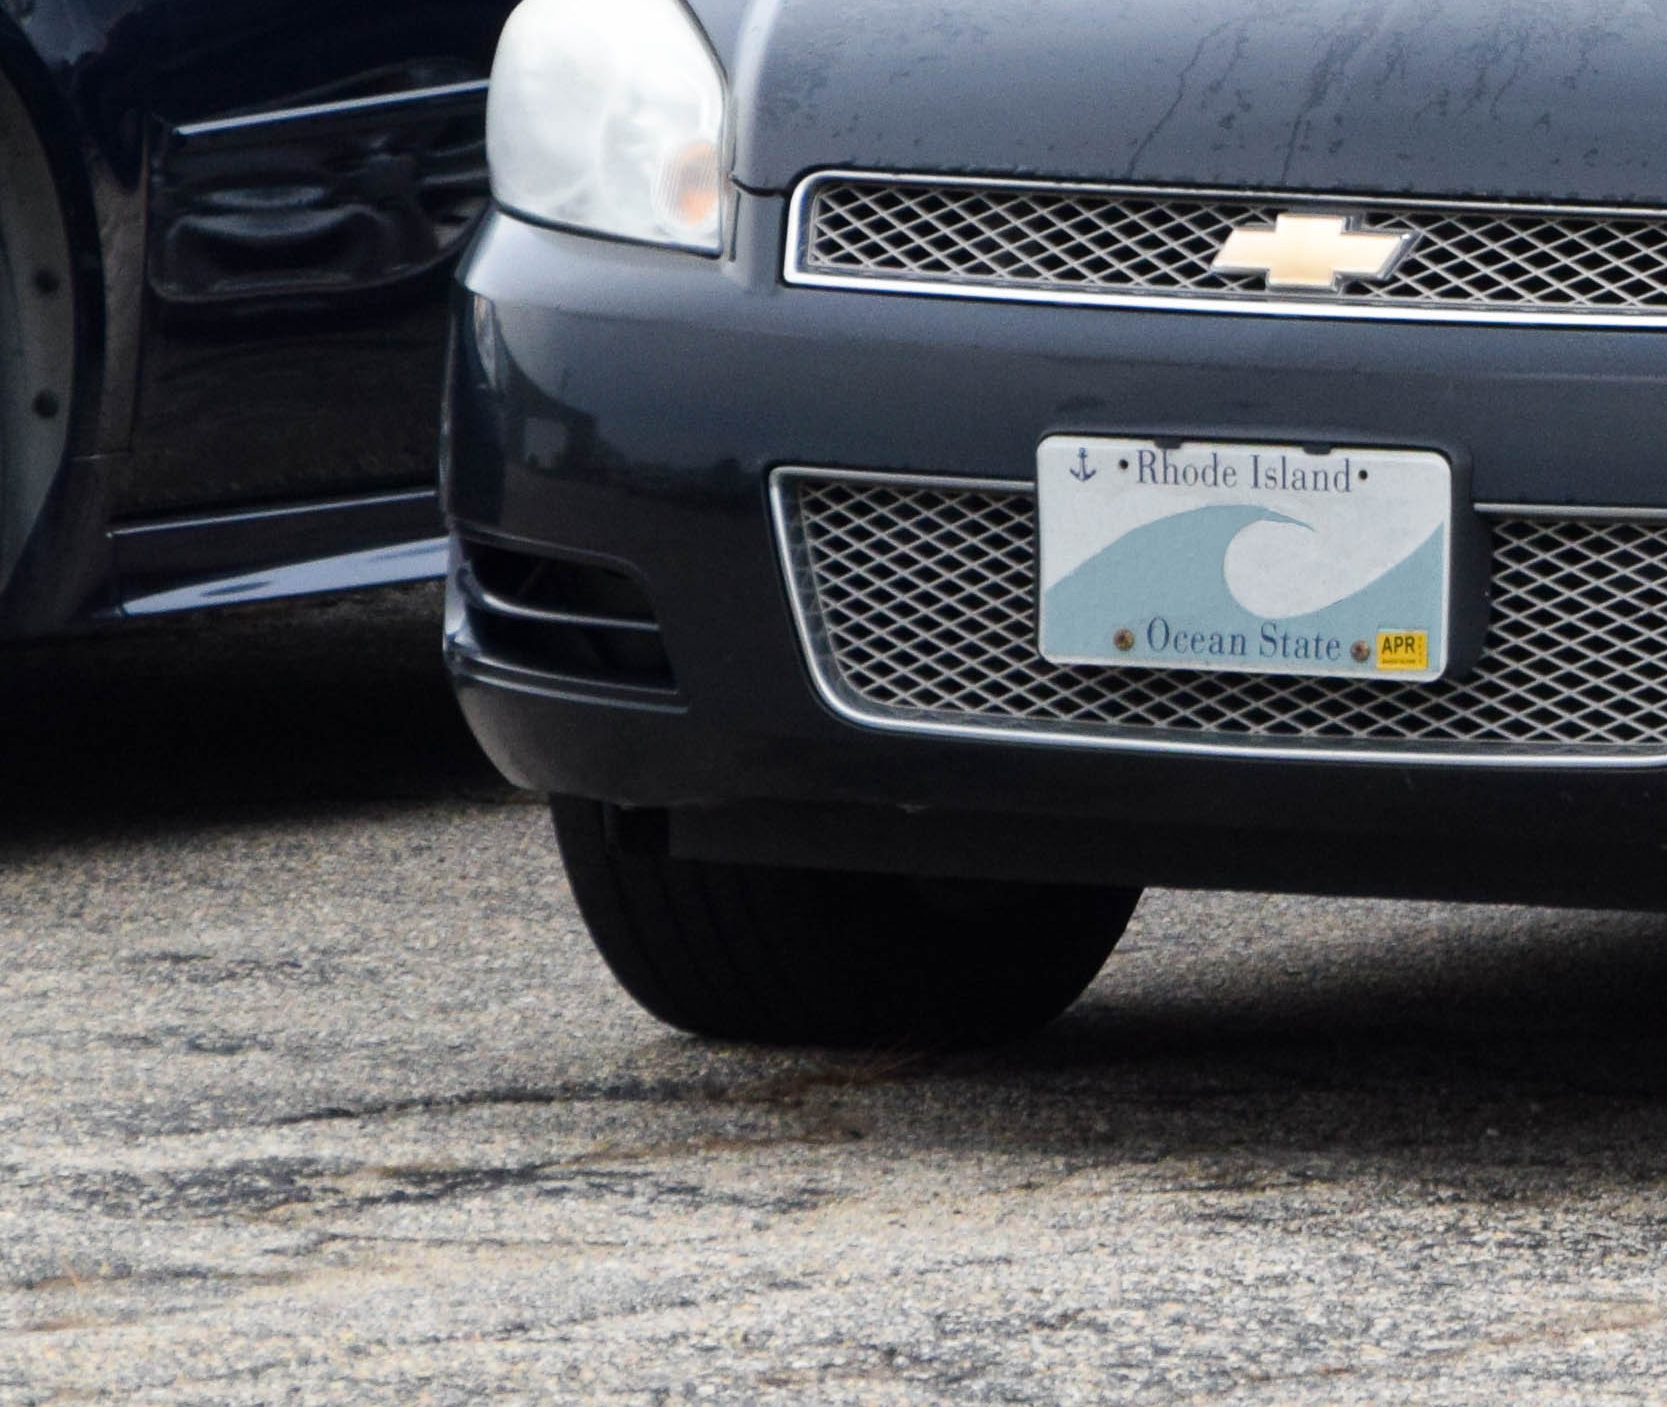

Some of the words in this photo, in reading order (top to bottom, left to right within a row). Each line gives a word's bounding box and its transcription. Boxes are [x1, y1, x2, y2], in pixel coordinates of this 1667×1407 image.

[1136, 449, 1237, 487] Rhode
[1250, 454, 1352, 493] Island
[1147, 617, 1247, 656] Ocean
[1259, 622, 1341, 661] State
[1381, 635, 1416, 654] APR
